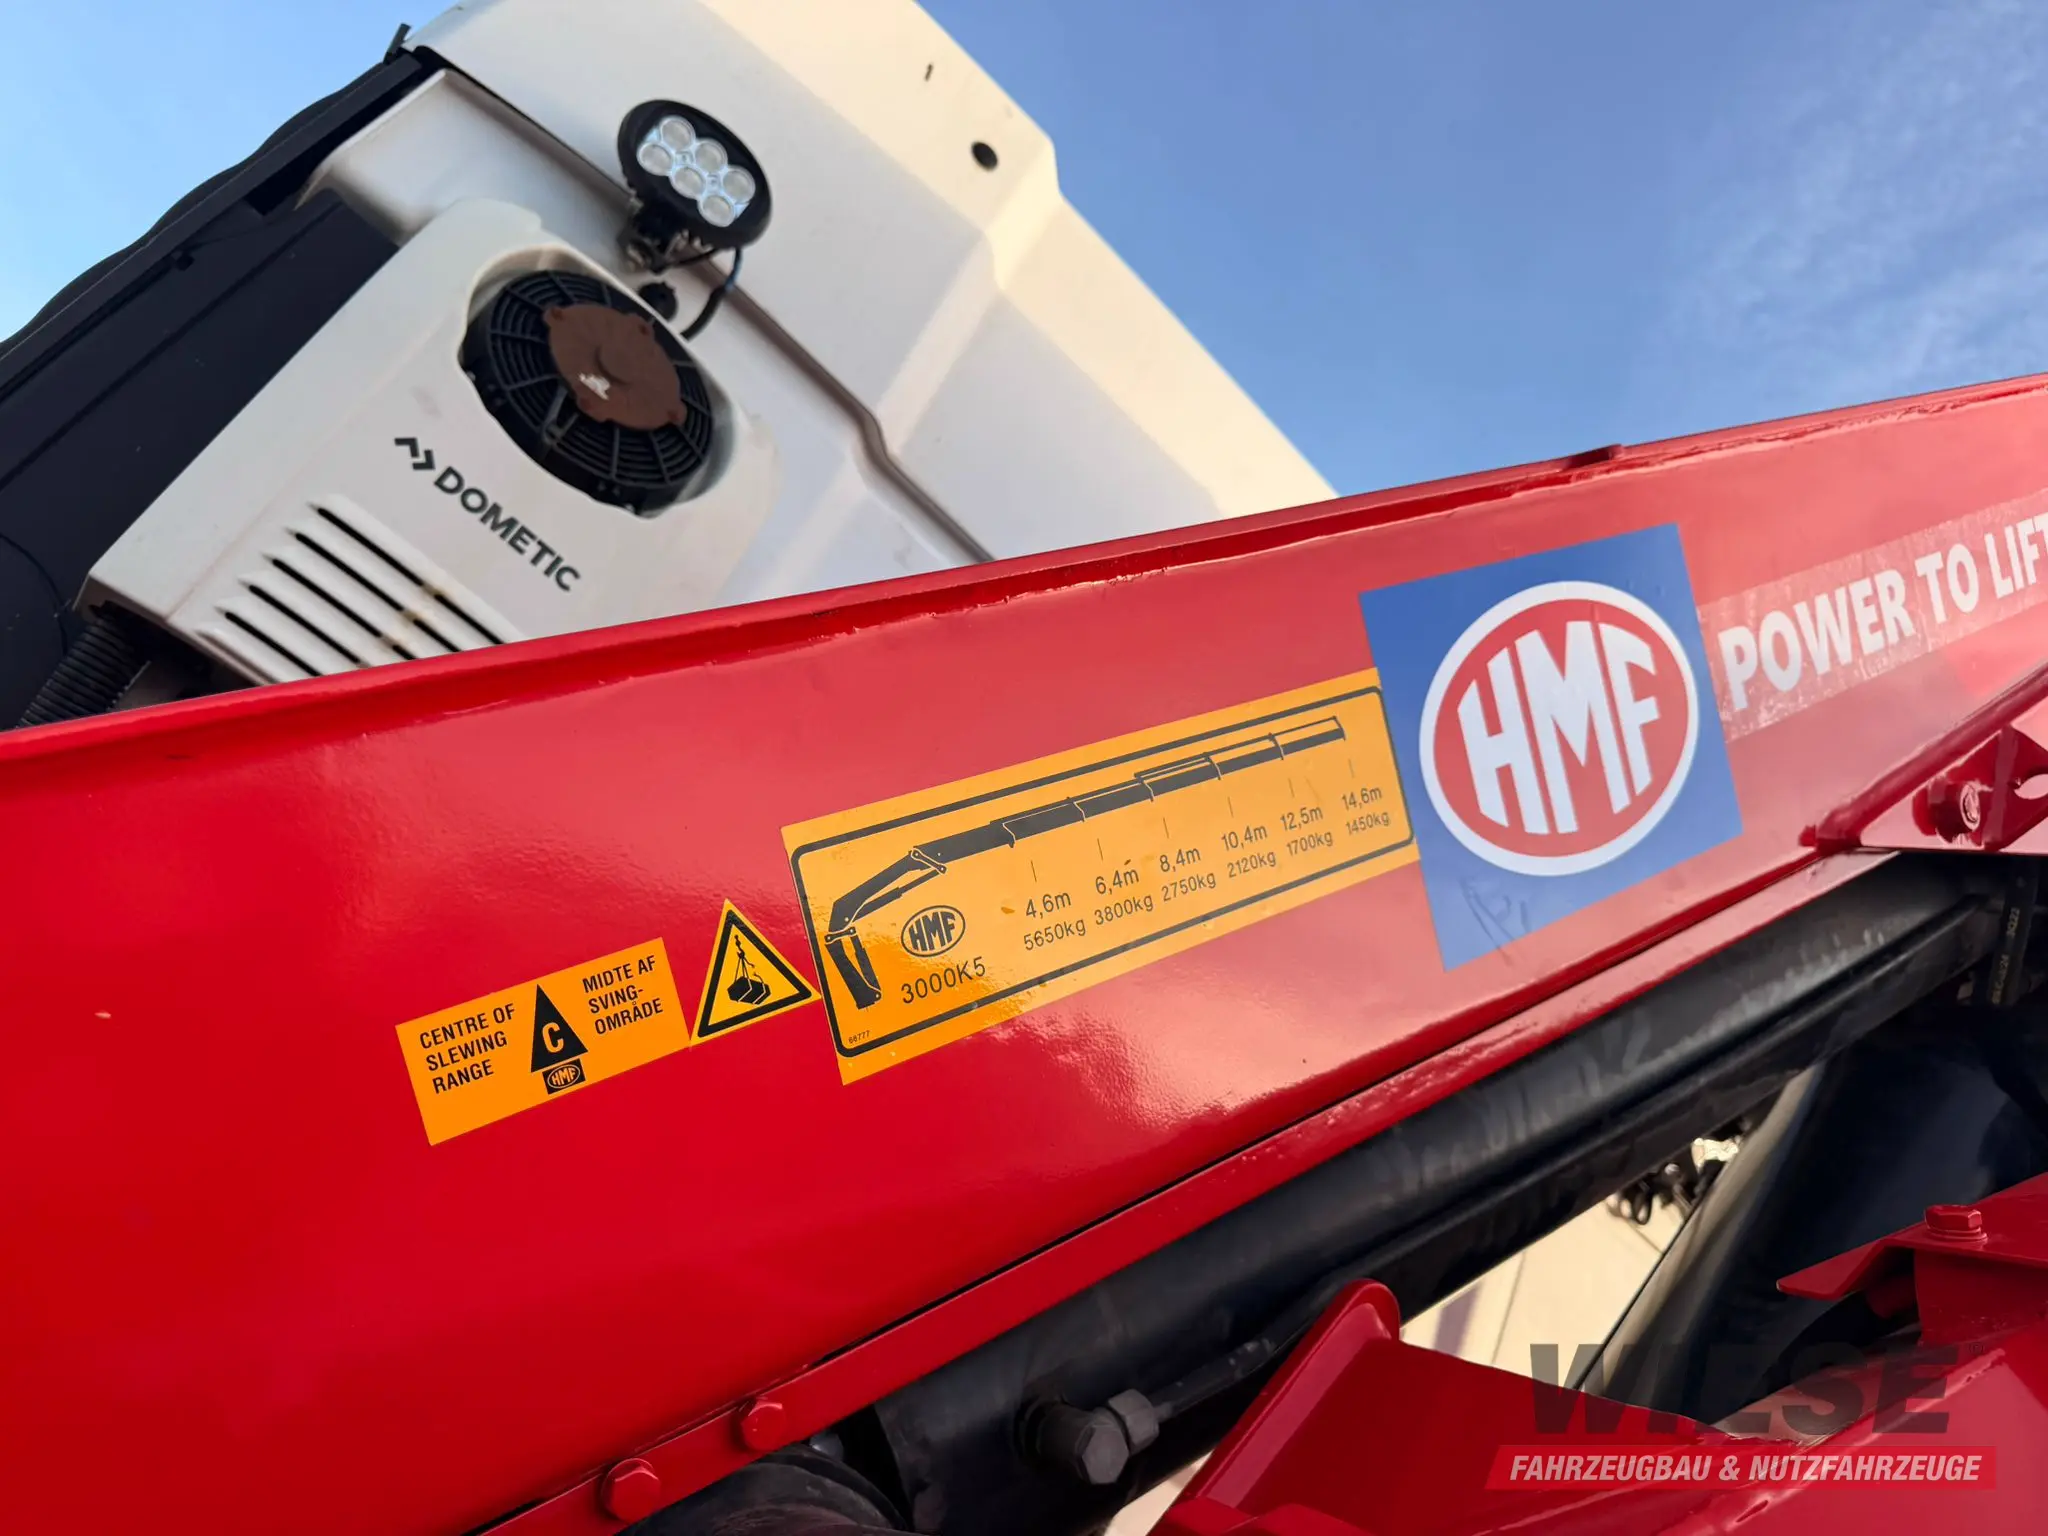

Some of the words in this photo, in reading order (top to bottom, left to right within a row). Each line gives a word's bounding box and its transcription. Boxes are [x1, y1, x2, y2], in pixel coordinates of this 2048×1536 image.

[433, 465, 581, 592] DOMETIC
[1717, 569, 1916, 711] POWER
[1914, 543, 1980, 624] TO
[1457, 620, 1660, 835] HMF
[1026, 891, 1071, 919] 4,6m
[1094, 868, 1139, 895] 6,4m
[1159, 848, 1200, 873] 8,4m
[1221, 825, 1268, 851] 10,4m
[1280, 806, 1323, 831] 12,5m
[1341, 785, 1383, 811] 14,6m
[1024, 917, 1087, 951] 5650kg
[1094, 894, 1154, 925] 3800kg
[1161, 871, 1217, 902] 2750kg
[1227, 850, 1277, 878] 2120kg
[1286, 831, 1333, 856] 1700kg
[1345, 811, 1390, 835] 1450kg
[908, 911, 956, 951] HMF
[582, 963, 634, 993] MIDTE
[638, 955, 657, 975] AF
[901, 956, 986, 1004] 3000K5
[588, 985, 644, 1015] SVING-
[594, 998, 664, 1035] OMRÅDE
[419, 1011, 489, 1049] CENTRE
[492, 1003, 515, 1024] OF
[542, 1022, 564, 1054] C
[425, 1030, 508, 1072] SLEWING
[432, 1059, 494, 1094] RANGE
[549, 1066, 579, 1087] HMF
